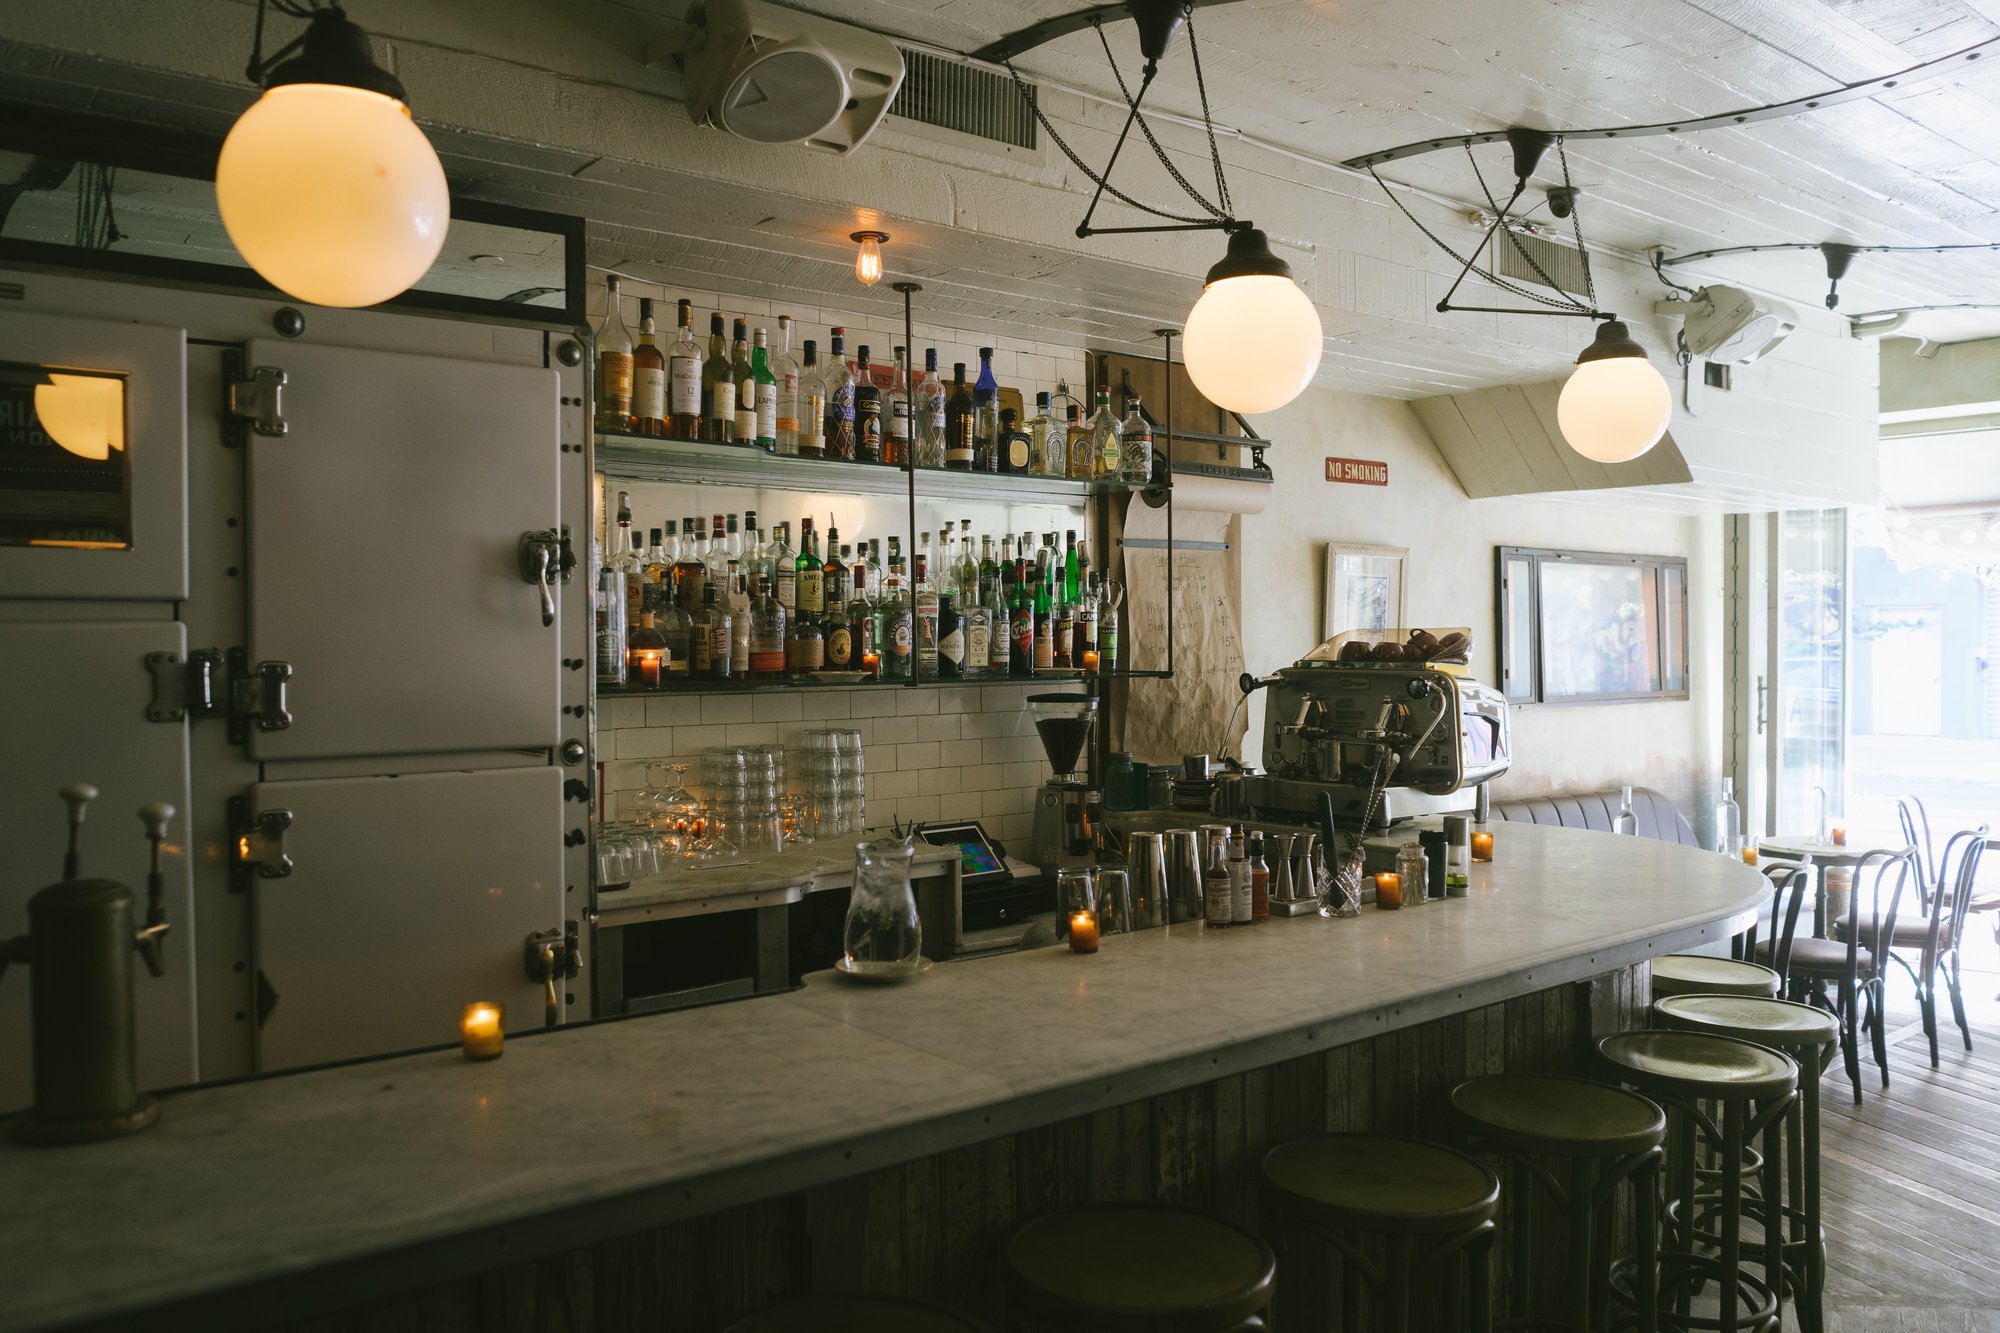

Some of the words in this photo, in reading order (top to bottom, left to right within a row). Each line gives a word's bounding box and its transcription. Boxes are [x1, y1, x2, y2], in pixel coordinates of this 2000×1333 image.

[687, 387, 695, 395] 12
[1328, 461, 1342, 478] NO
[1345, 463, 1386, 482] SMOKING
[717, 628, 728, 655] KNOB
